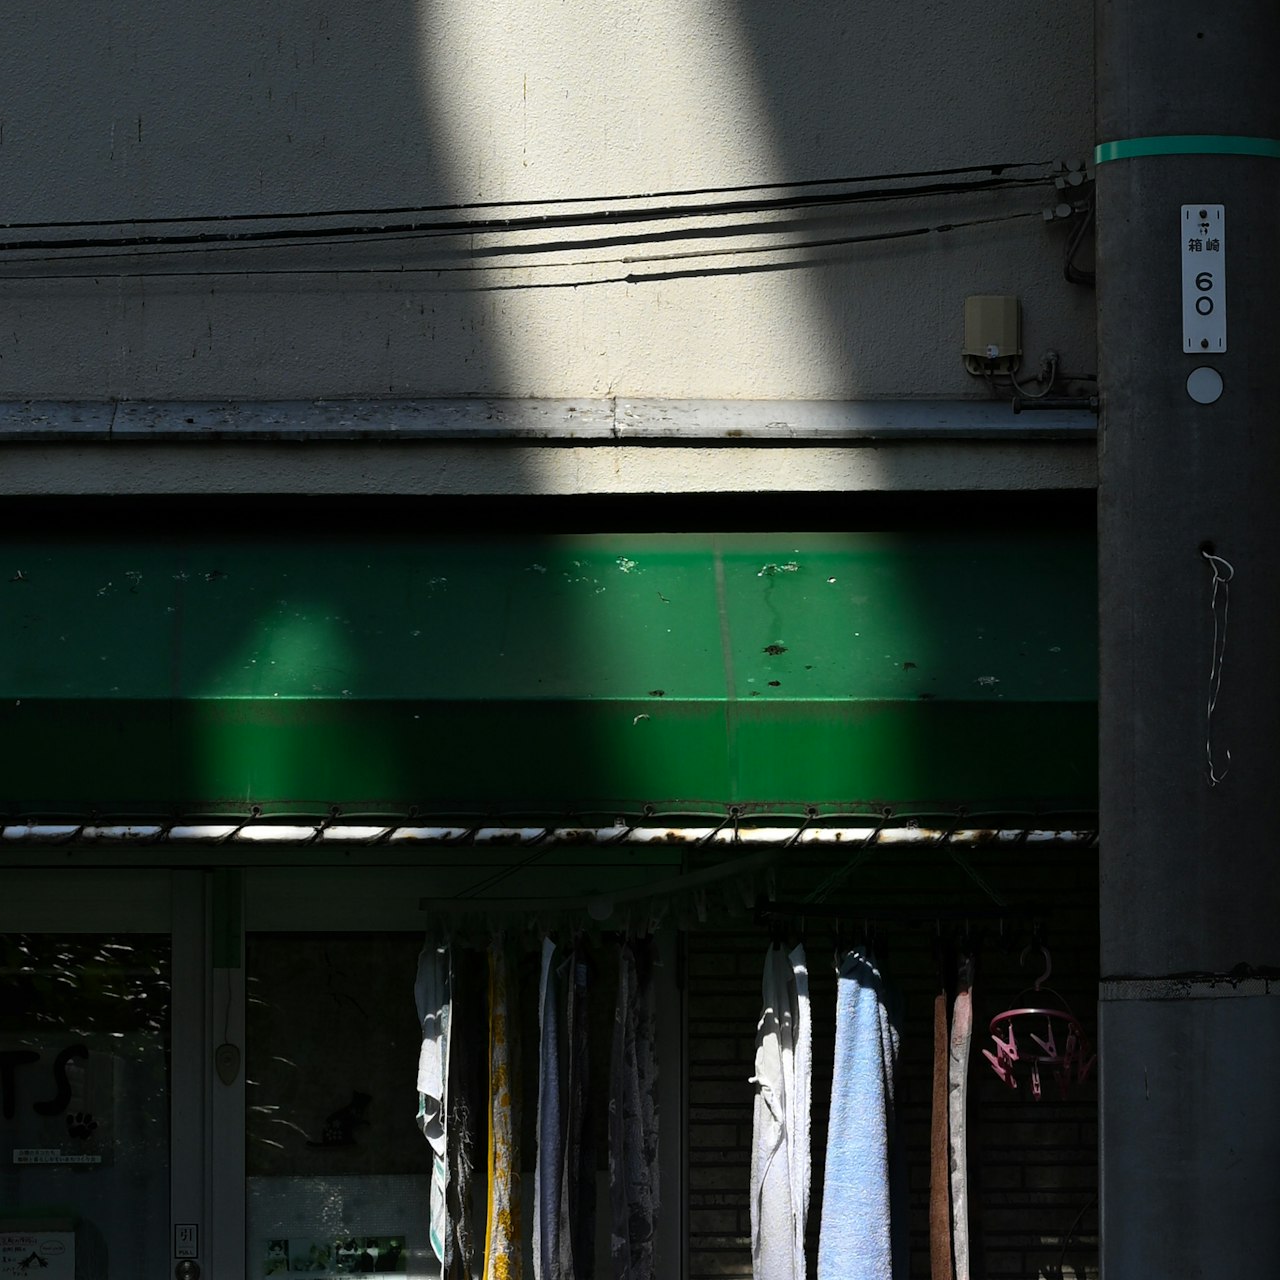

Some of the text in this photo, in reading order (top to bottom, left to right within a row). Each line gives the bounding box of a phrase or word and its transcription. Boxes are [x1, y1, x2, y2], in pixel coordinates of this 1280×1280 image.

[1188, 238, 1220, 252] 箱崎
[1195, 271, 1214, 316] 60
[180, 1228, 193, 1242] 引
